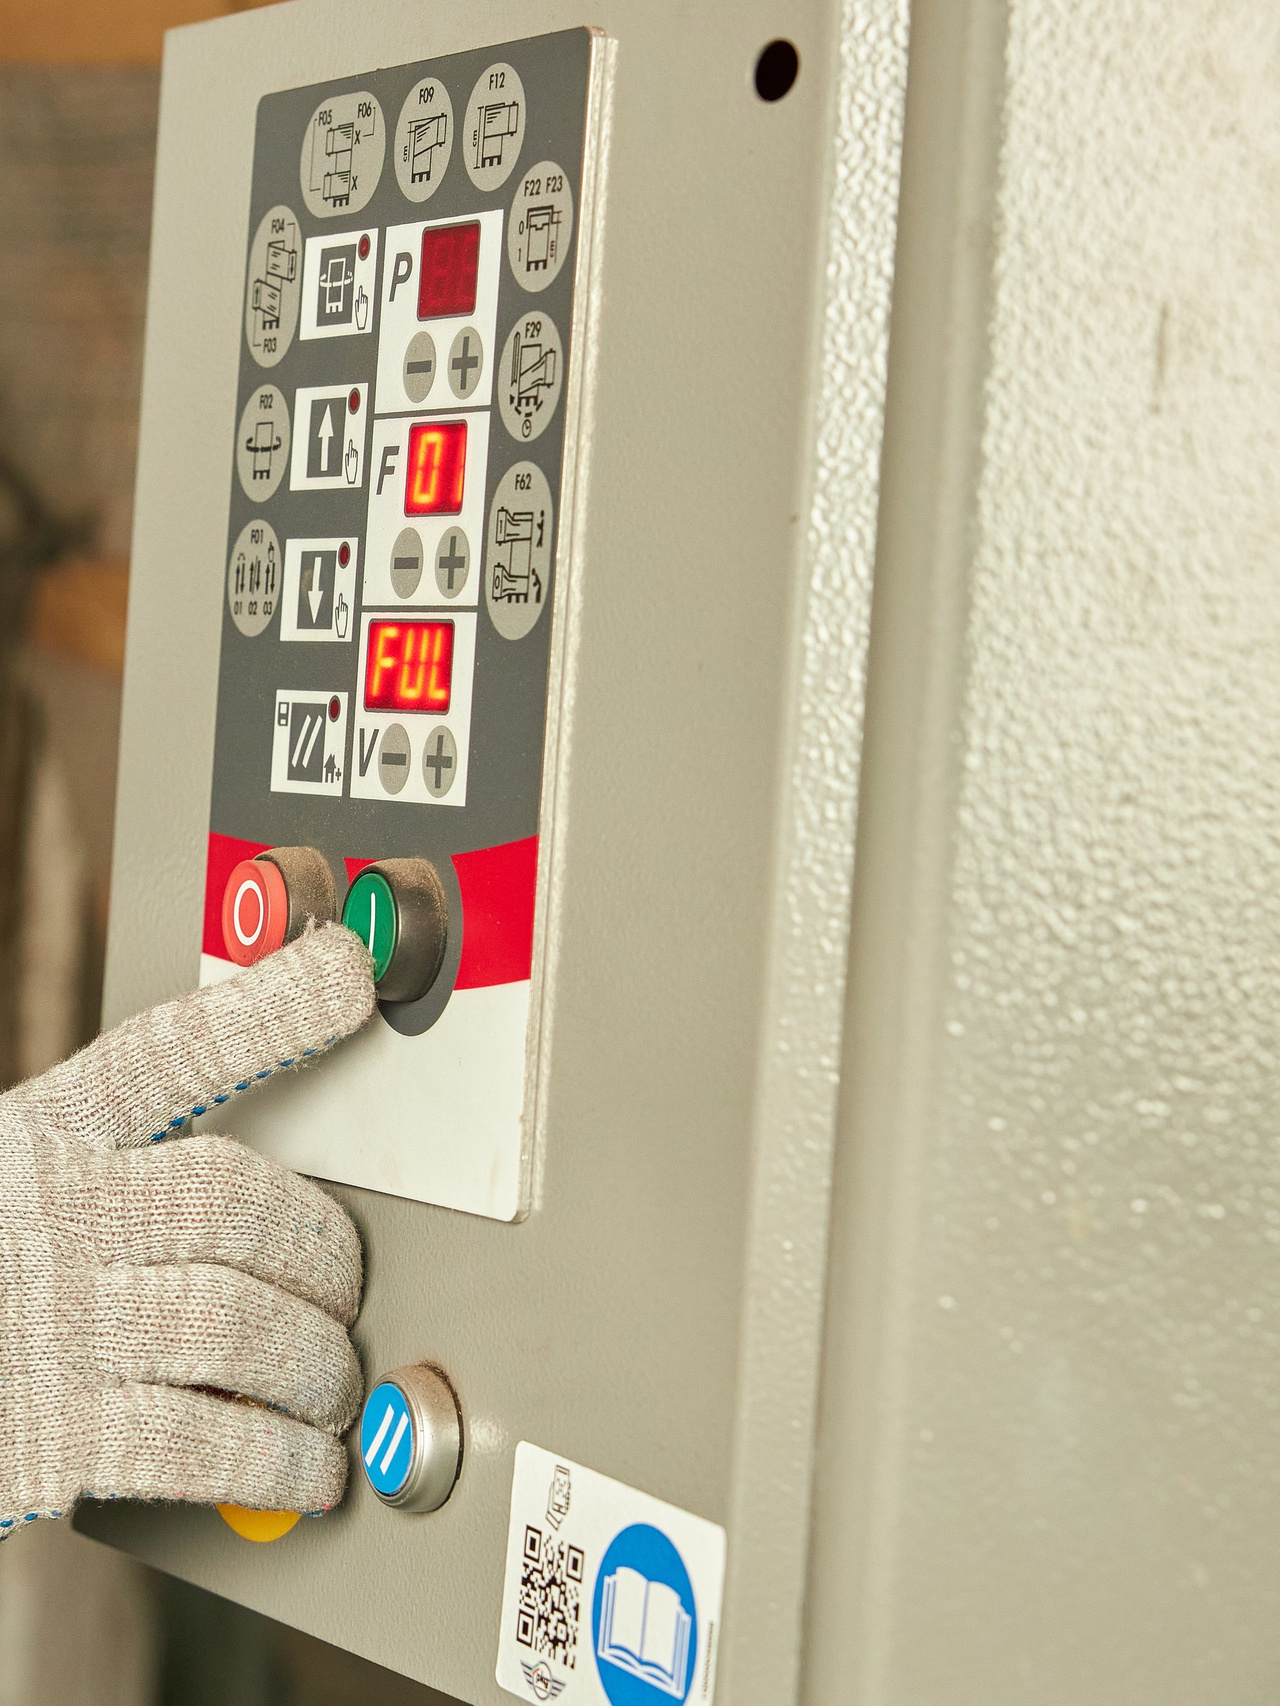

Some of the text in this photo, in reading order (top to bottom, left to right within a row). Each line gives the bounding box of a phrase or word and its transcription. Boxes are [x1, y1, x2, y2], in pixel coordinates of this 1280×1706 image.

[489, 73, 505, 90] F12
[418, 87, 435, 104] F09
[318, 110, 333, 126] F05
[357, 102, 372, 119] F06
[524, 175, 562, 197] F22 F23
[271, 218, 286, 234] F04
[389, 251, 413, 303] P
[525, 321, 542, 339] F29
[262, 338, 277, 354] F03
[259, 393, 273, 409] F02
[376, 445, 400, 496] F
[514, 473, 532, 491] F62
[250, 528, 265, 545] F01
[233, 602, 273, 616] 01 02 03
[358, 728, 379, 778] V
